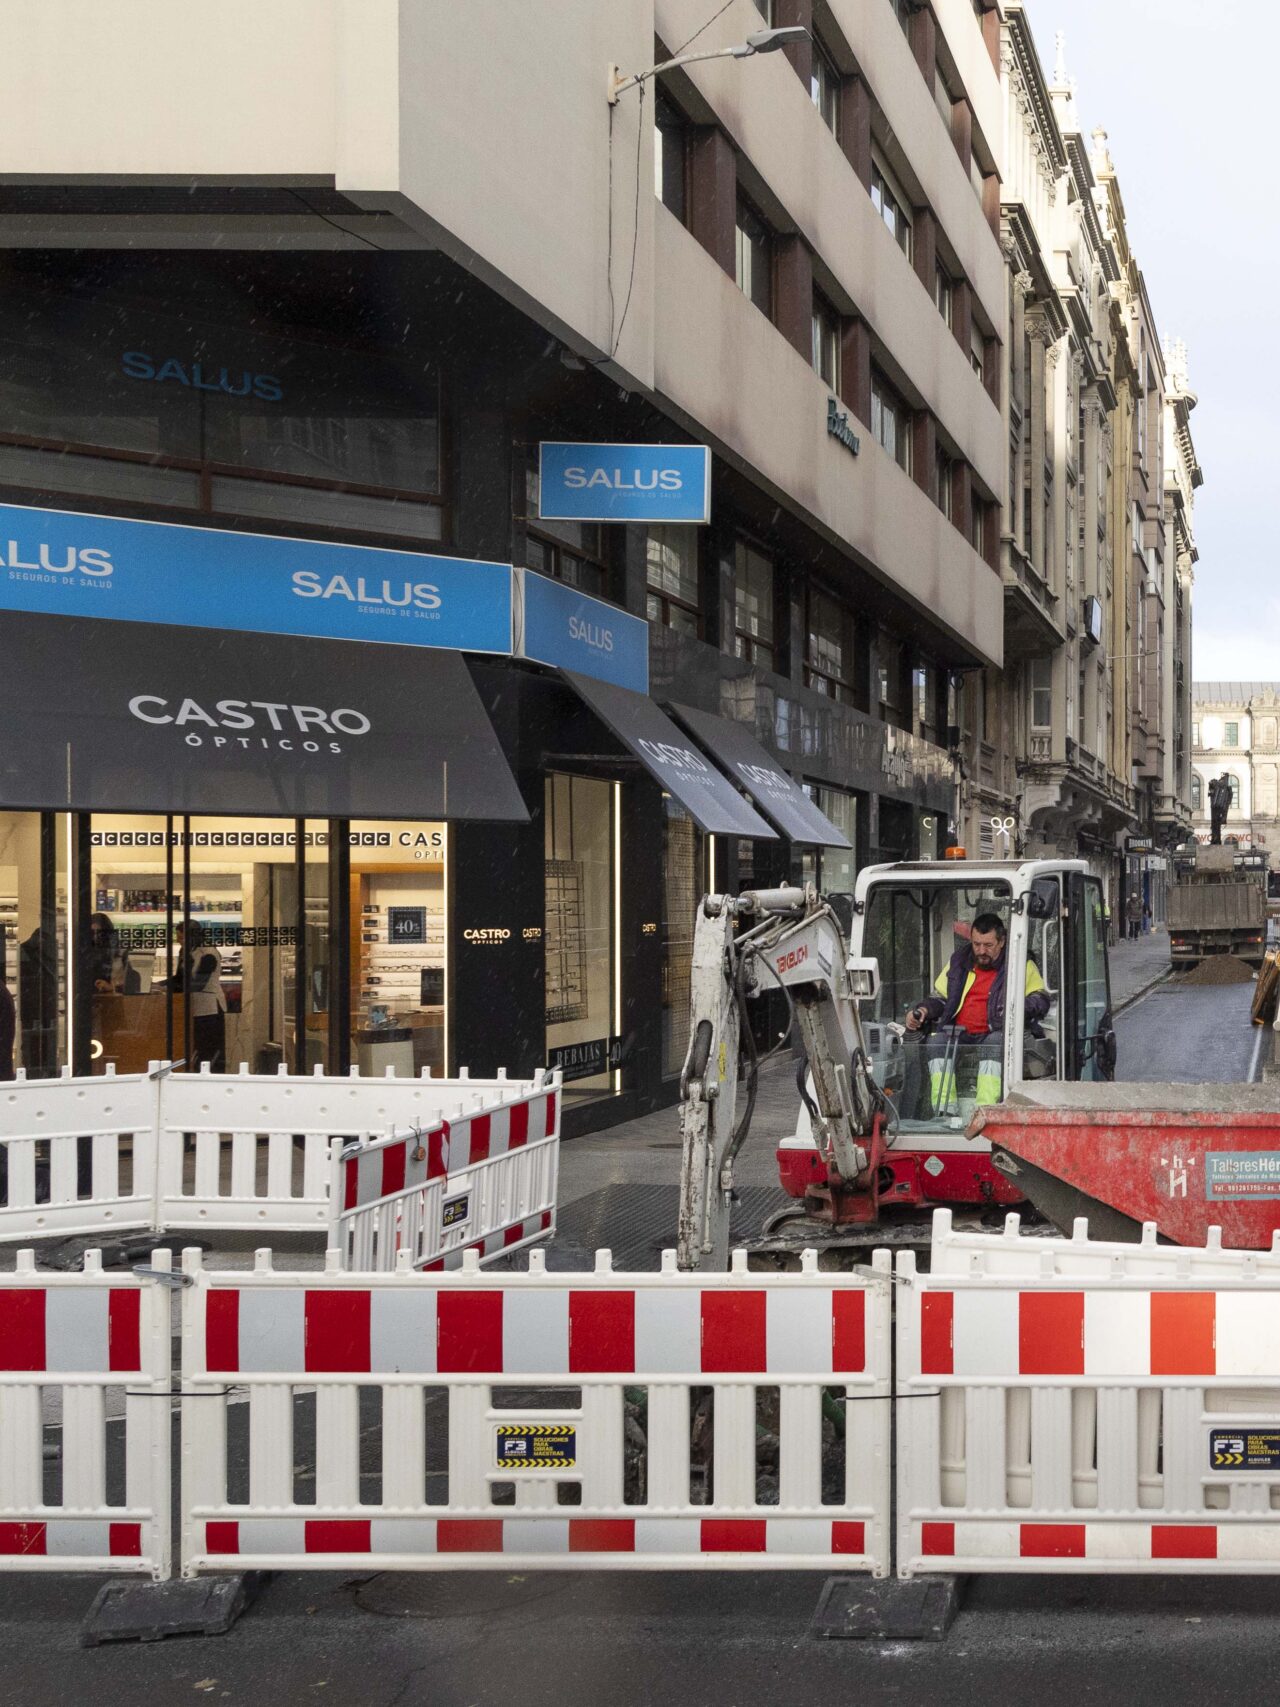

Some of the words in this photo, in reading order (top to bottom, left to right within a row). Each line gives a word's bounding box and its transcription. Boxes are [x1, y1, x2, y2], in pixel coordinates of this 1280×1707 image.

[122, 351, 283, 400] SALUS
[564, 467, 683, 490] SALUS
[0, 540, 114, 577] LUS
[9, 571, 57, 584] SEGUROS
[62, 576, 75, 585] DE
[80, 578, 113, 589] SALUD
[291, 571, 442, 609] SALUS
[357, 605, 397, 616] SEGUROS
[415, 611, 441, 620] SALUD
[568, 616, 614, 652] SALUS
[128, 694, 371, 735] CASTRO
[185, 732, 342, 753] ÓPTICOS
[638, 738, 708, 773] CASTRO
[737, 762, 791, 790] CASTRO
[463, 929, 511, 940] CASTRO
[522, 928, 541, 938] CASTRO
[557, 1043, 600, 1067] REBAJAS
[504, 1441, 527, 1450] F3
[1214, 1440, 1244, 1453] F3
